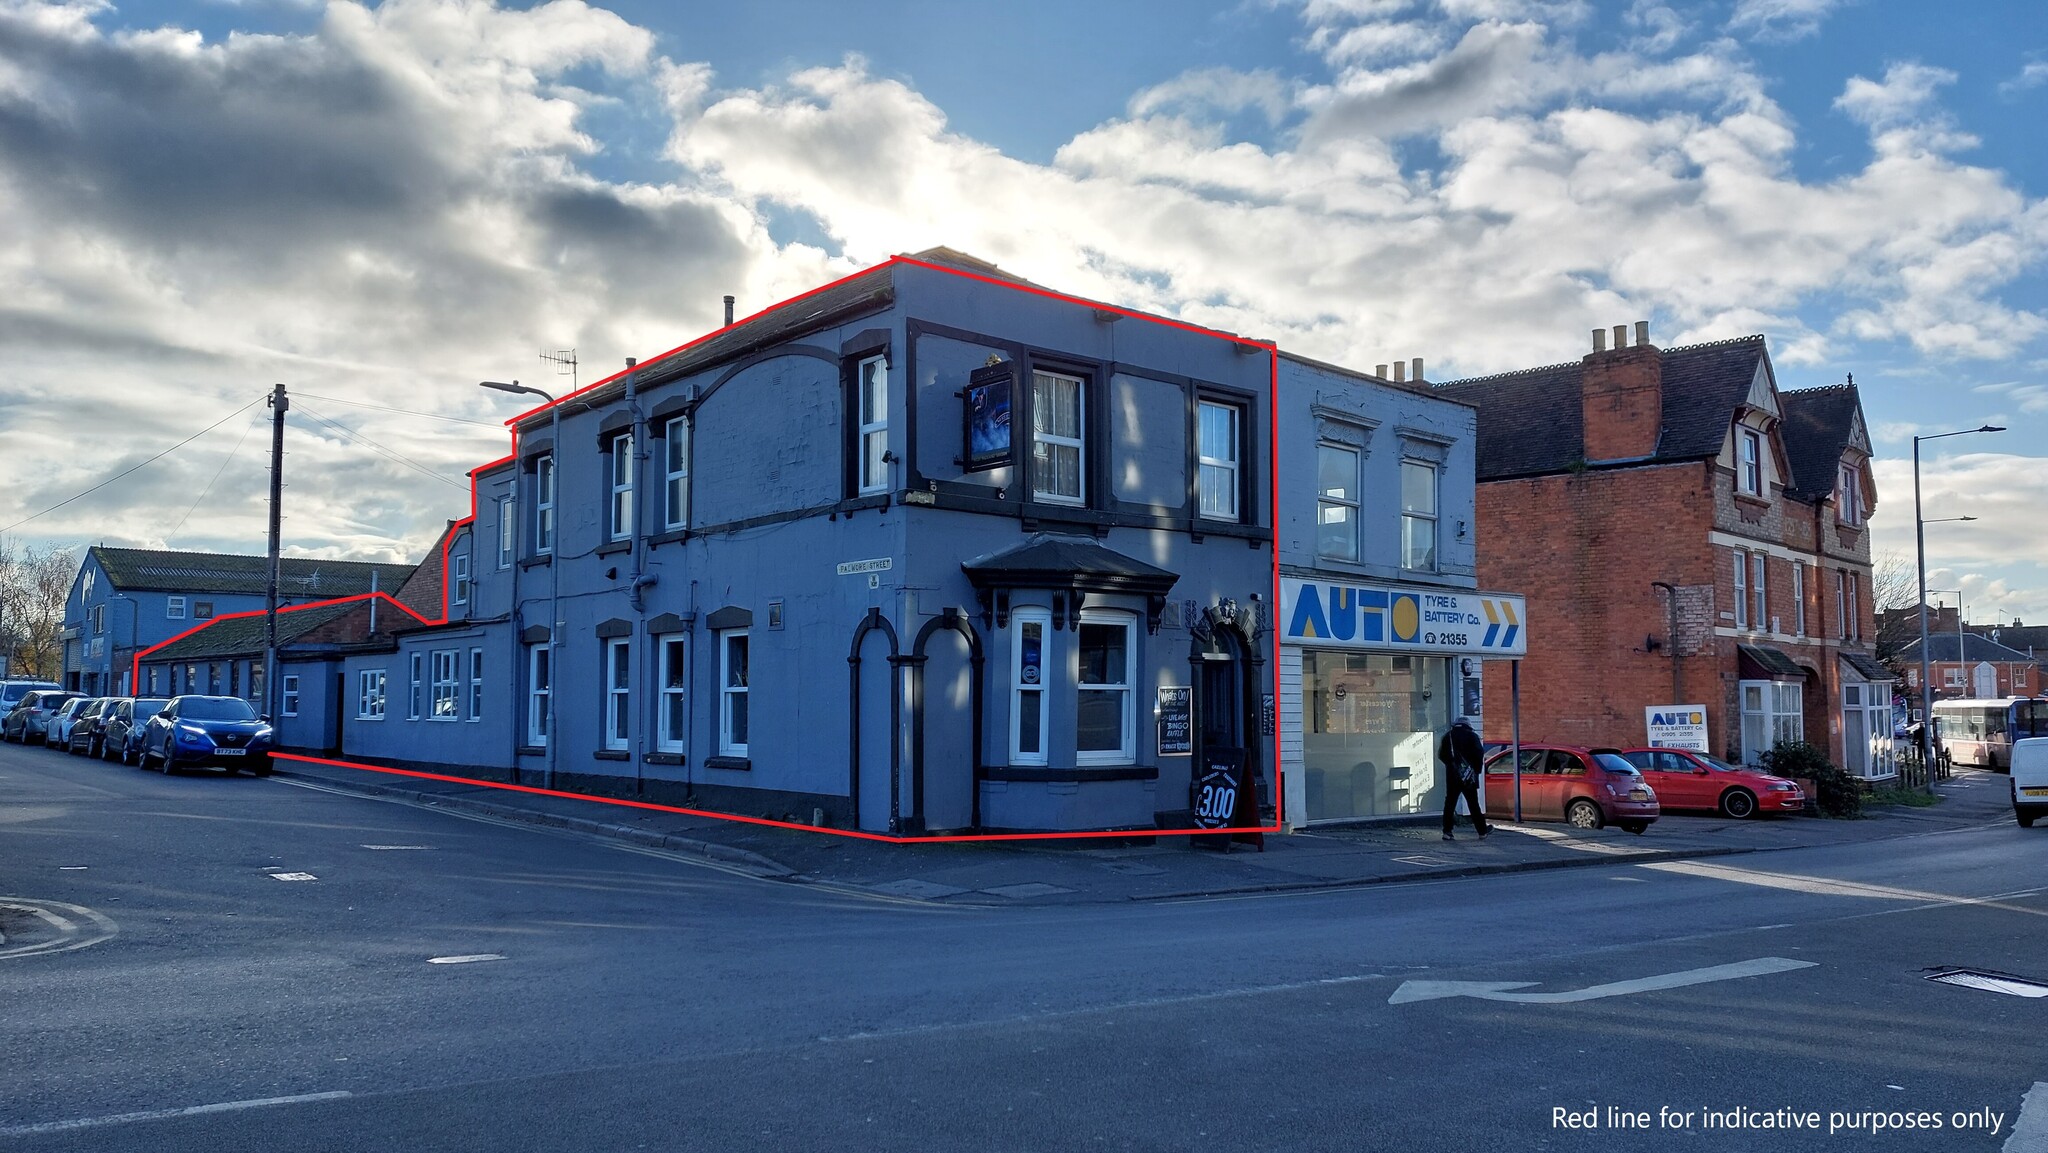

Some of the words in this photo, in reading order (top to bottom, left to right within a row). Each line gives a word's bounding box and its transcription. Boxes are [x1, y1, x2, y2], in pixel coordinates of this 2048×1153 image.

[870, 560, 890, 570] STREET
[1425, 595, 1449, 608] TYRE
[1451, 597, 1457, 608] &
[1288, 584, 1420, 643] AUTO
[1425, 611, 1464, 625] BATTERY
[1467, 615, 1481, 626] Co.
[1440, 633, 1468, 645] 21355
[1651, 712, 1703, 725] AUTO
[1167, 722, 1189, 730] BINGO
